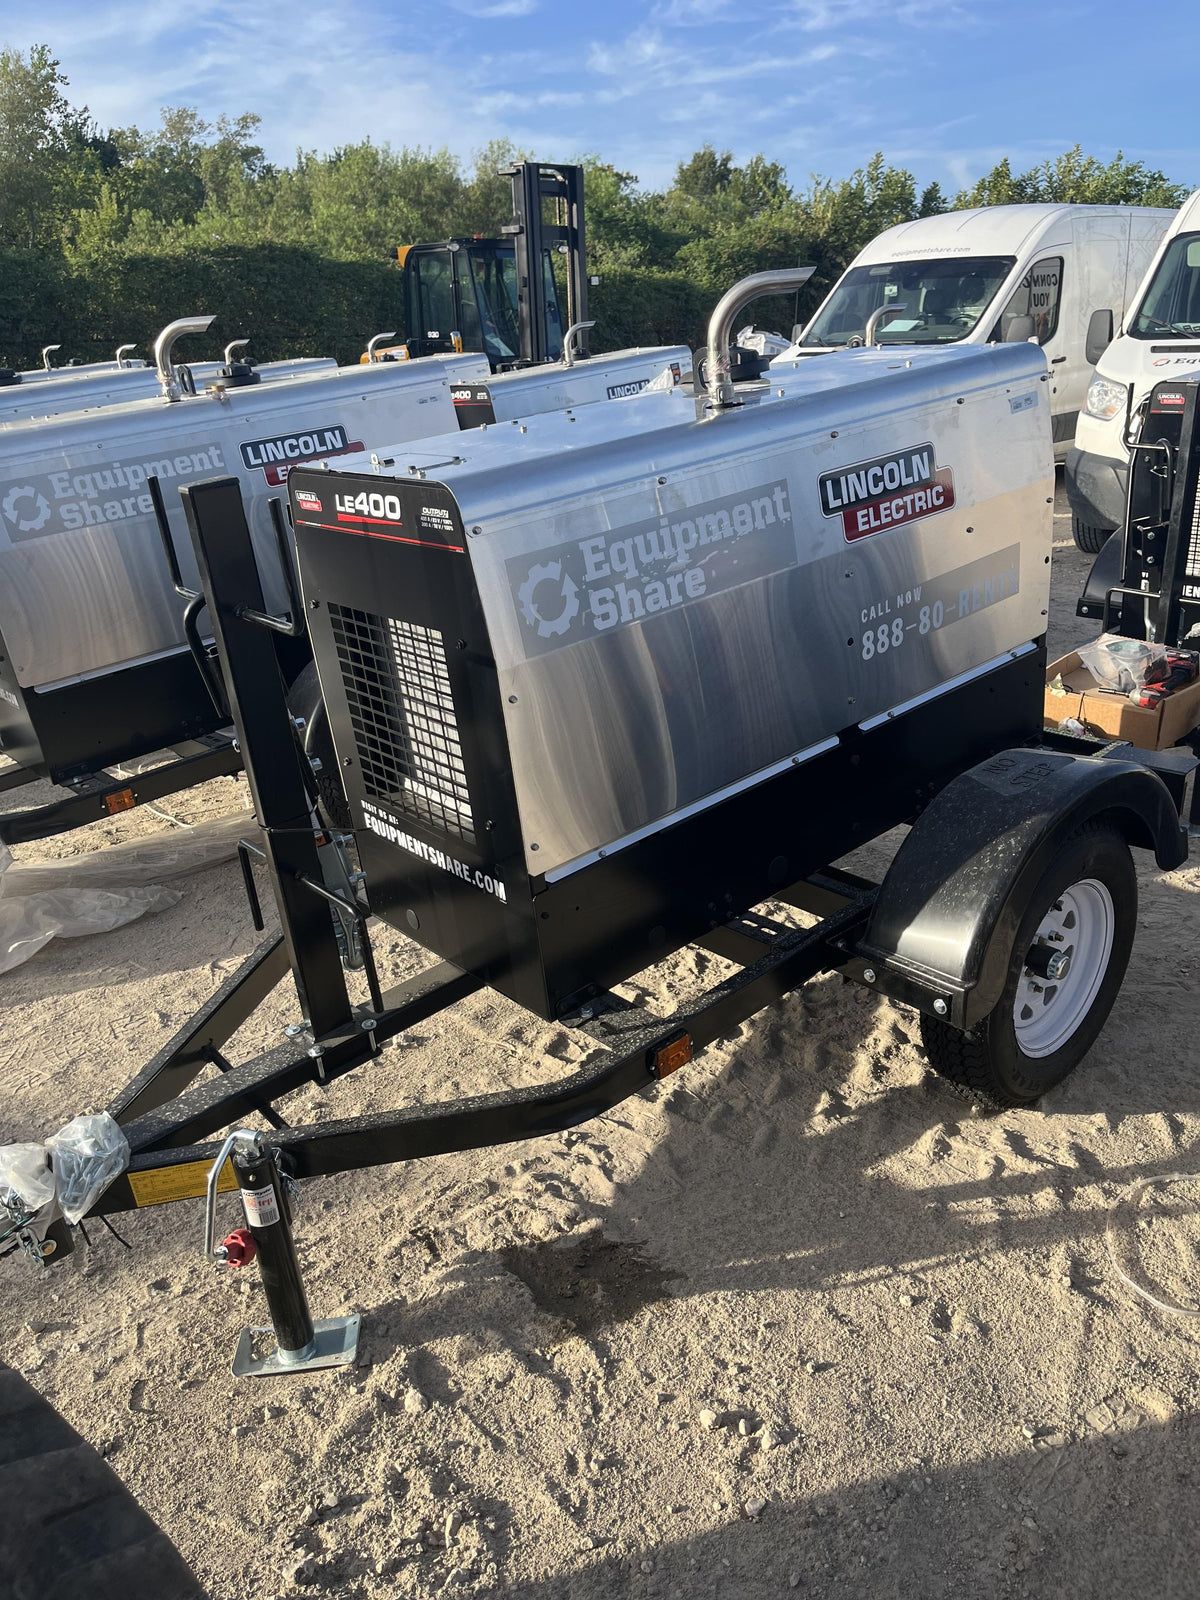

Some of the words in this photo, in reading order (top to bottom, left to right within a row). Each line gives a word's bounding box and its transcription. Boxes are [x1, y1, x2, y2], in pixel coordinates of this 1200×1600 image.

[246, 430, 344, 466] LINCOLN
[47, 445, 225, 499] Equipment
[825, 452, 931, 509] LINCOLN
[58, 492, 157, 530] Share
[335, 492, 401, 520] LE400
[422, 507, 447, 516] OUTPUT
[856, 485, 945, 532] ELECTRIC
[578, 486, 791, 582] Equipment
[588, 566, 707, 631] Share
[861, 599, 891, 623] CALL
[896, 586, 922, 609] NOW
[862, 567, 1019, 661] 888-80-RENTS
[982, 758, 1017, 775] NO
[1008, 763, 1055, 788] STEP
[361, 799, 378, 815] VISIT
[378, 809, 388, 820] US
[363, 811, 507, 901] EQUIPMENTSHARE.COM
